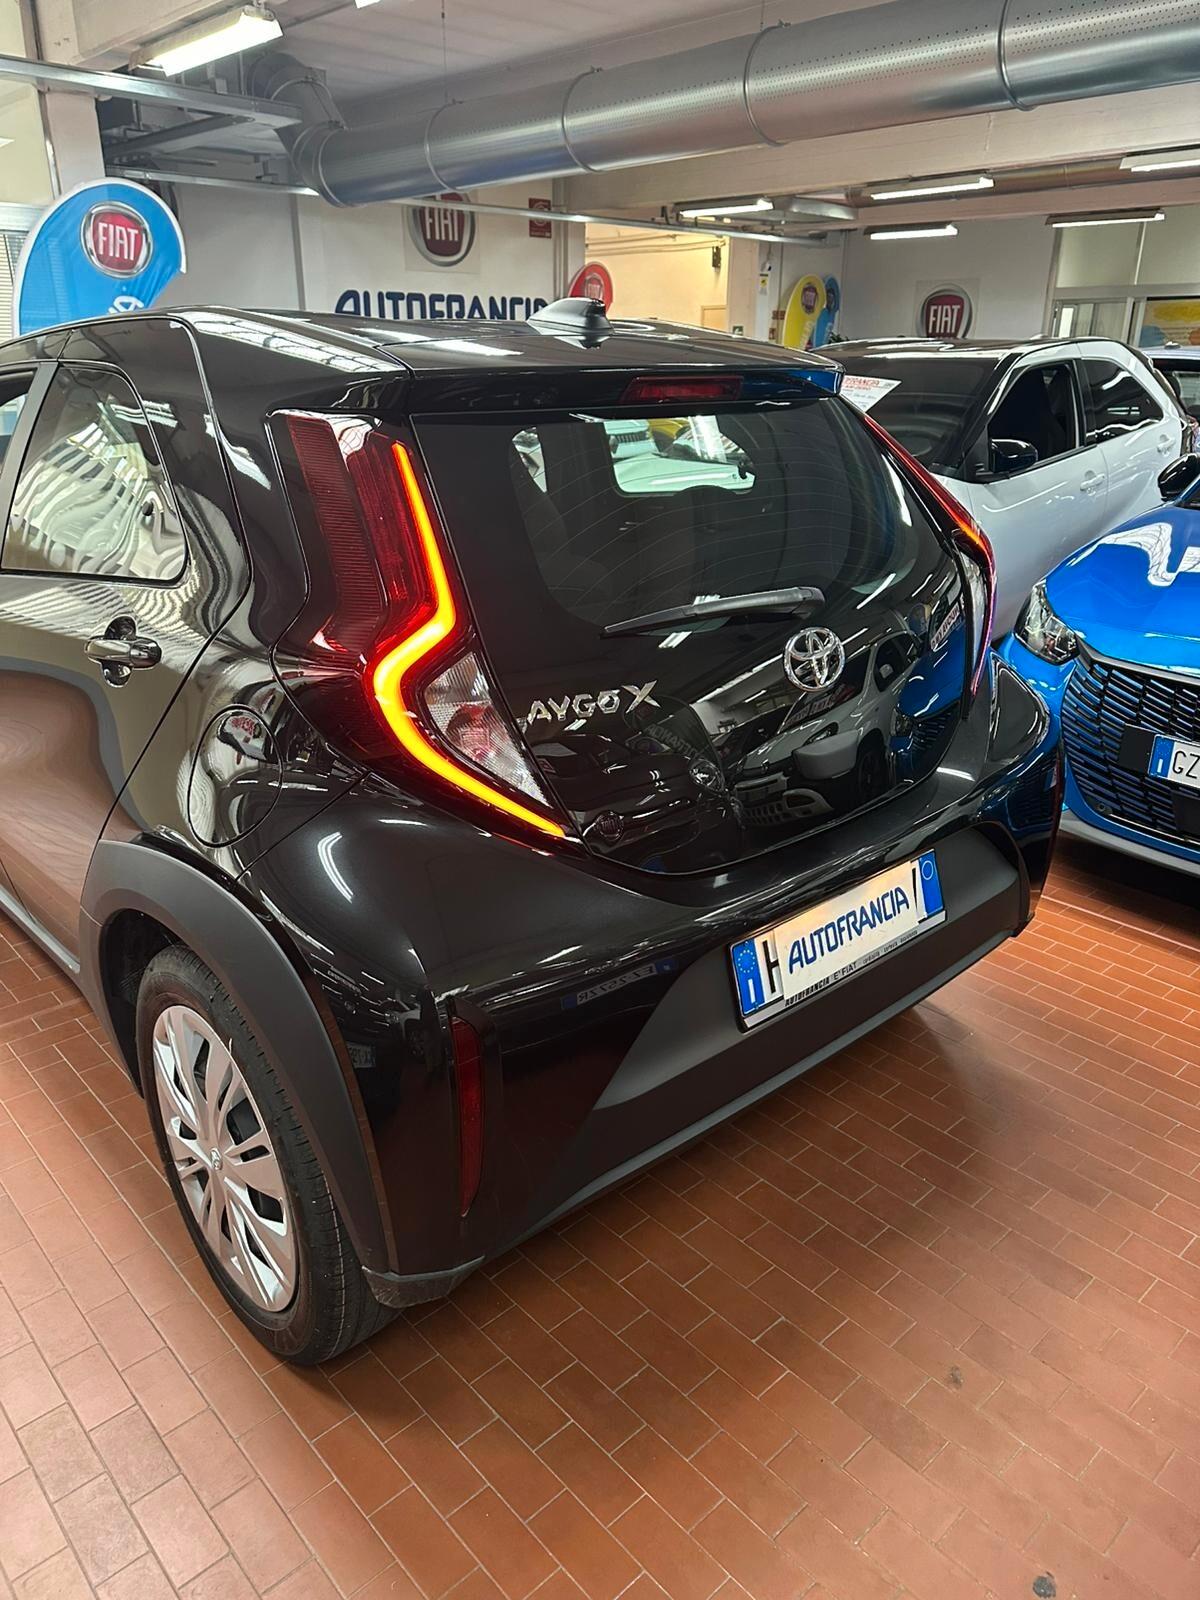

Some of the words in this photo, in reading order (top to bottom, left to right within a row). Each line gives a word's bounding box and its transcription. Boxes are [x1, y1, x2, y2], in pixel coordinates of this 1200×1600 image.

[97, 221, 139, 261] FIAT
[928, 304, 961, 334] FIAT
[527, 688, 621, 725] AYGO
[620, 679, 662, 714] X
[788, 886, 910, 975] AUTOFRANCIA
[785, 978, 830, 1006] AUTOFRANCIA
[841, 961, 858, 976] FIAT
